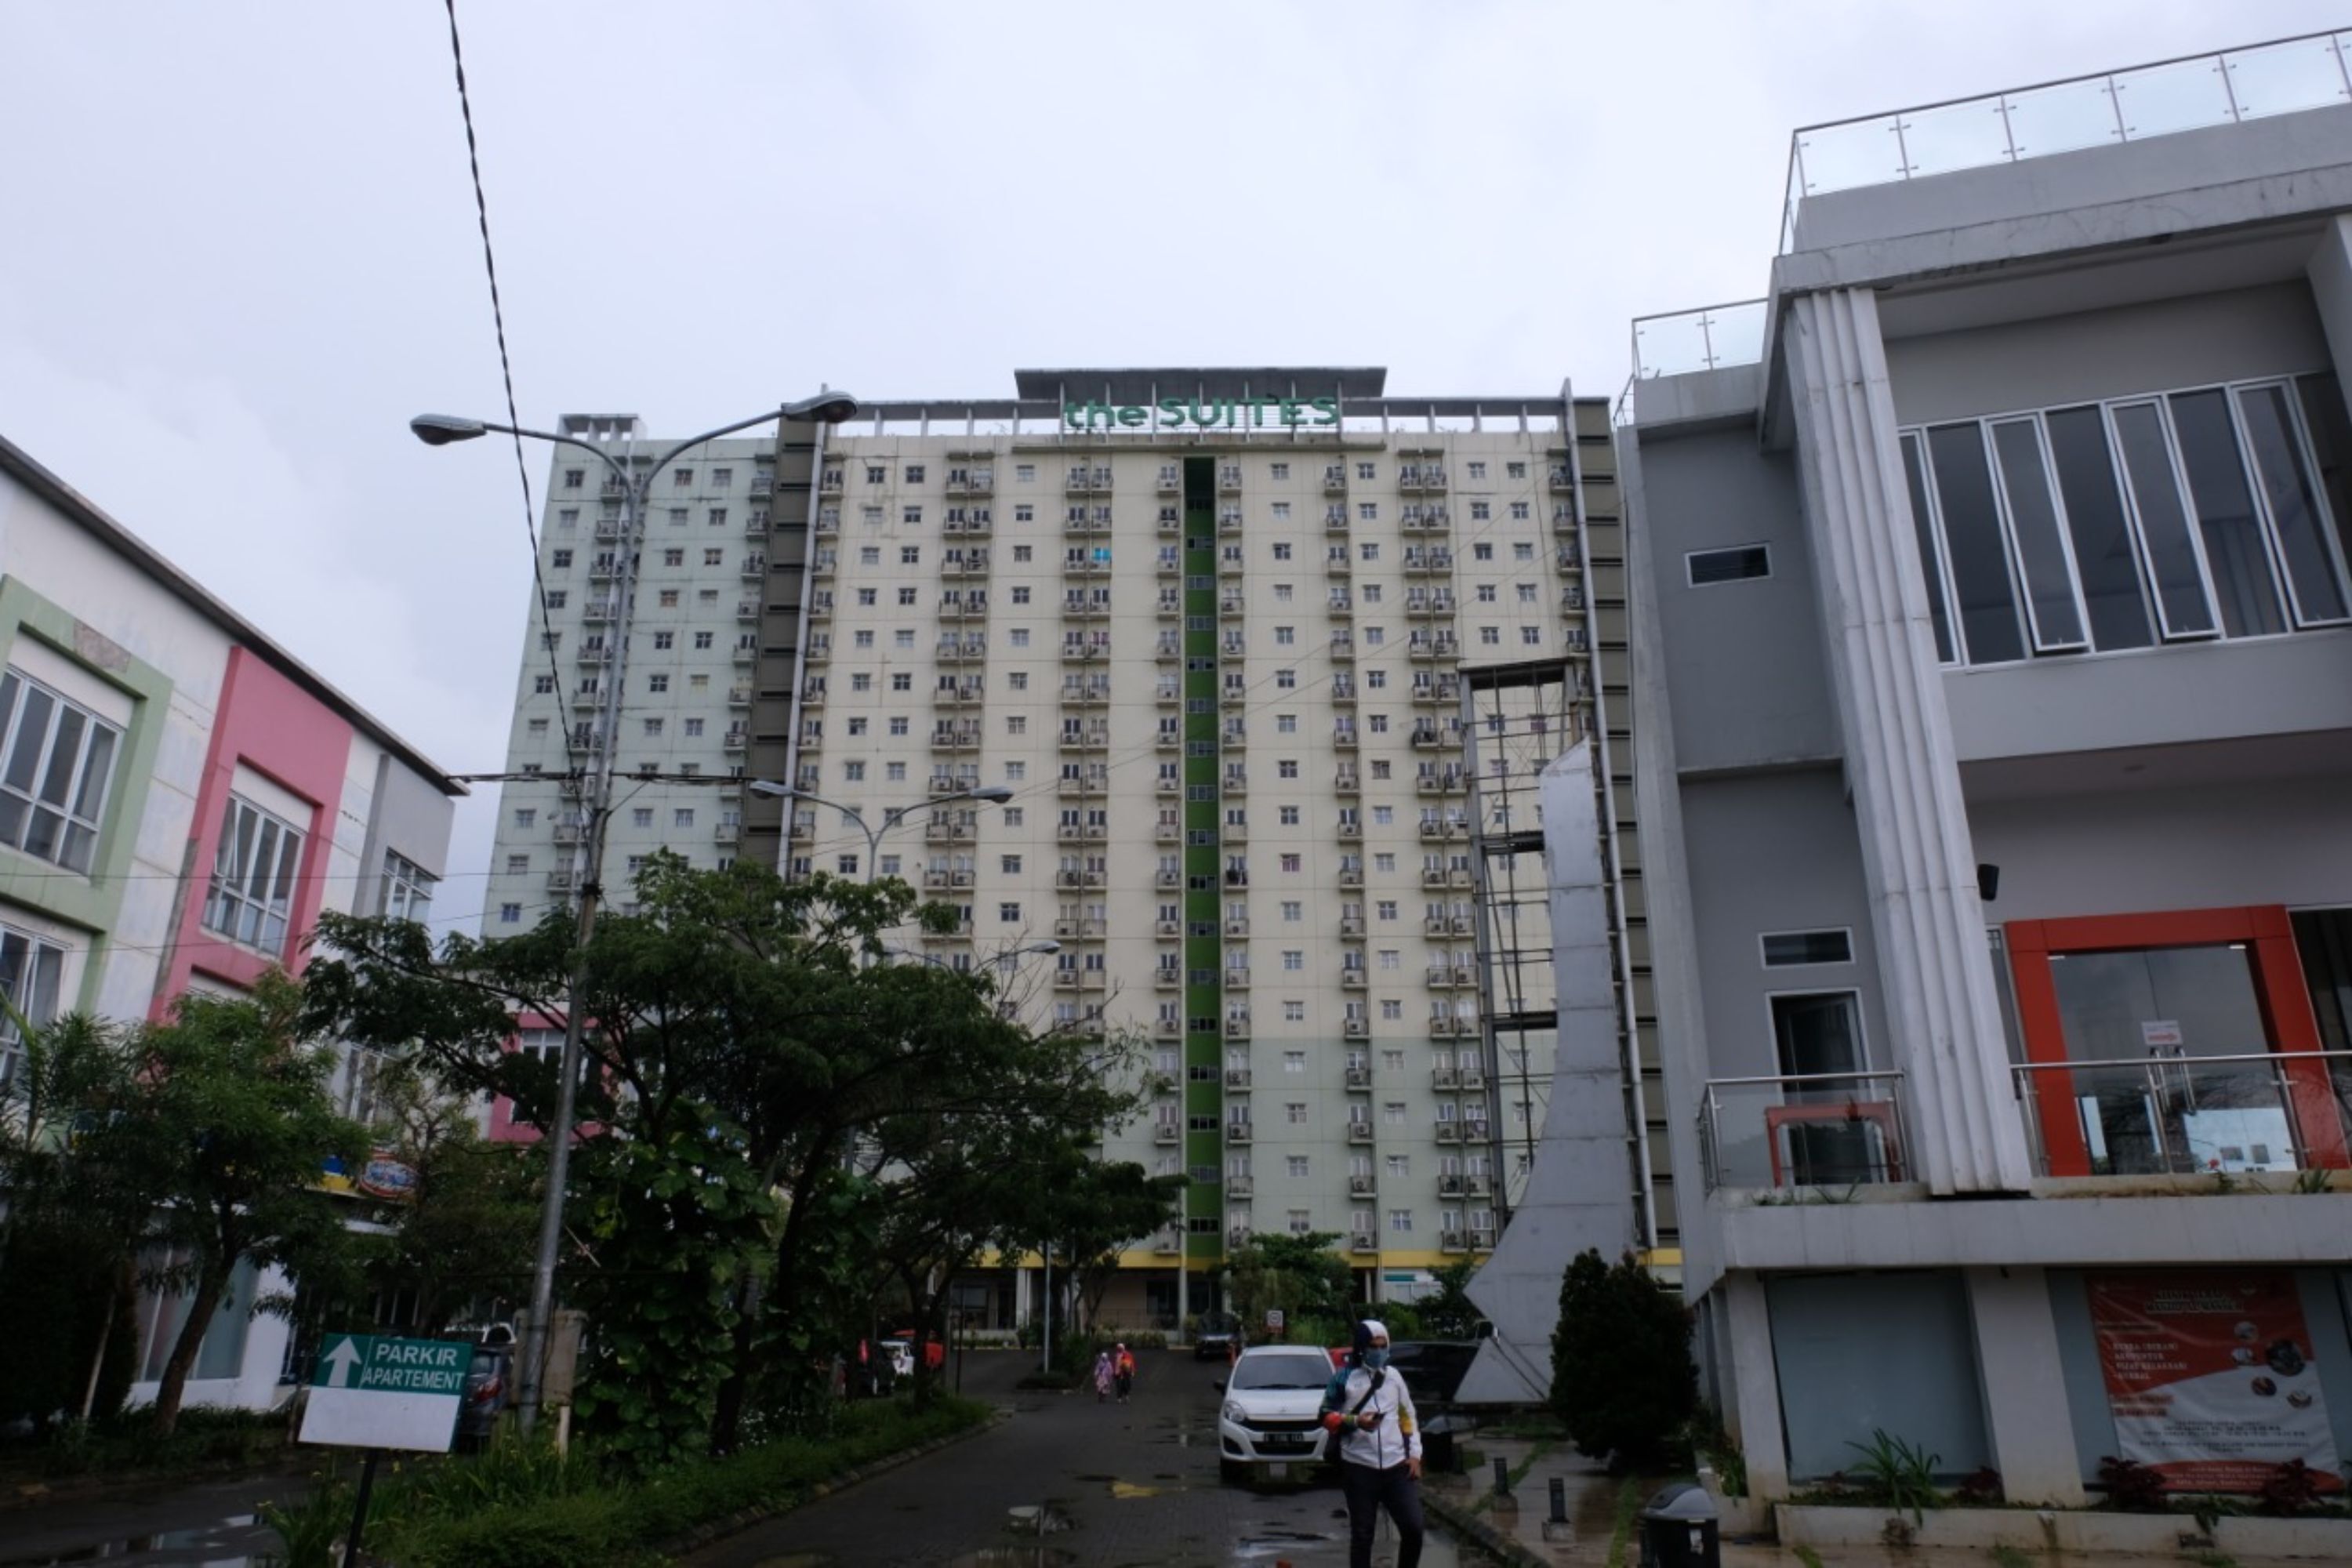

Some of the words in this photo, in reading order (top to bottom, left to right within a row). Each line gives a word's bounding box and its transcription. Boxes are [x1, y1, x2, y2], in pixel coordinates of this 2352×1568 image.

[1064, 399, 1148, 426] the
[1159, 397, 1339, 426] SUITES
[376, 1344, 458, 1367] PARKIR
[362, 1367, 465, 1389] APARTEMENT
